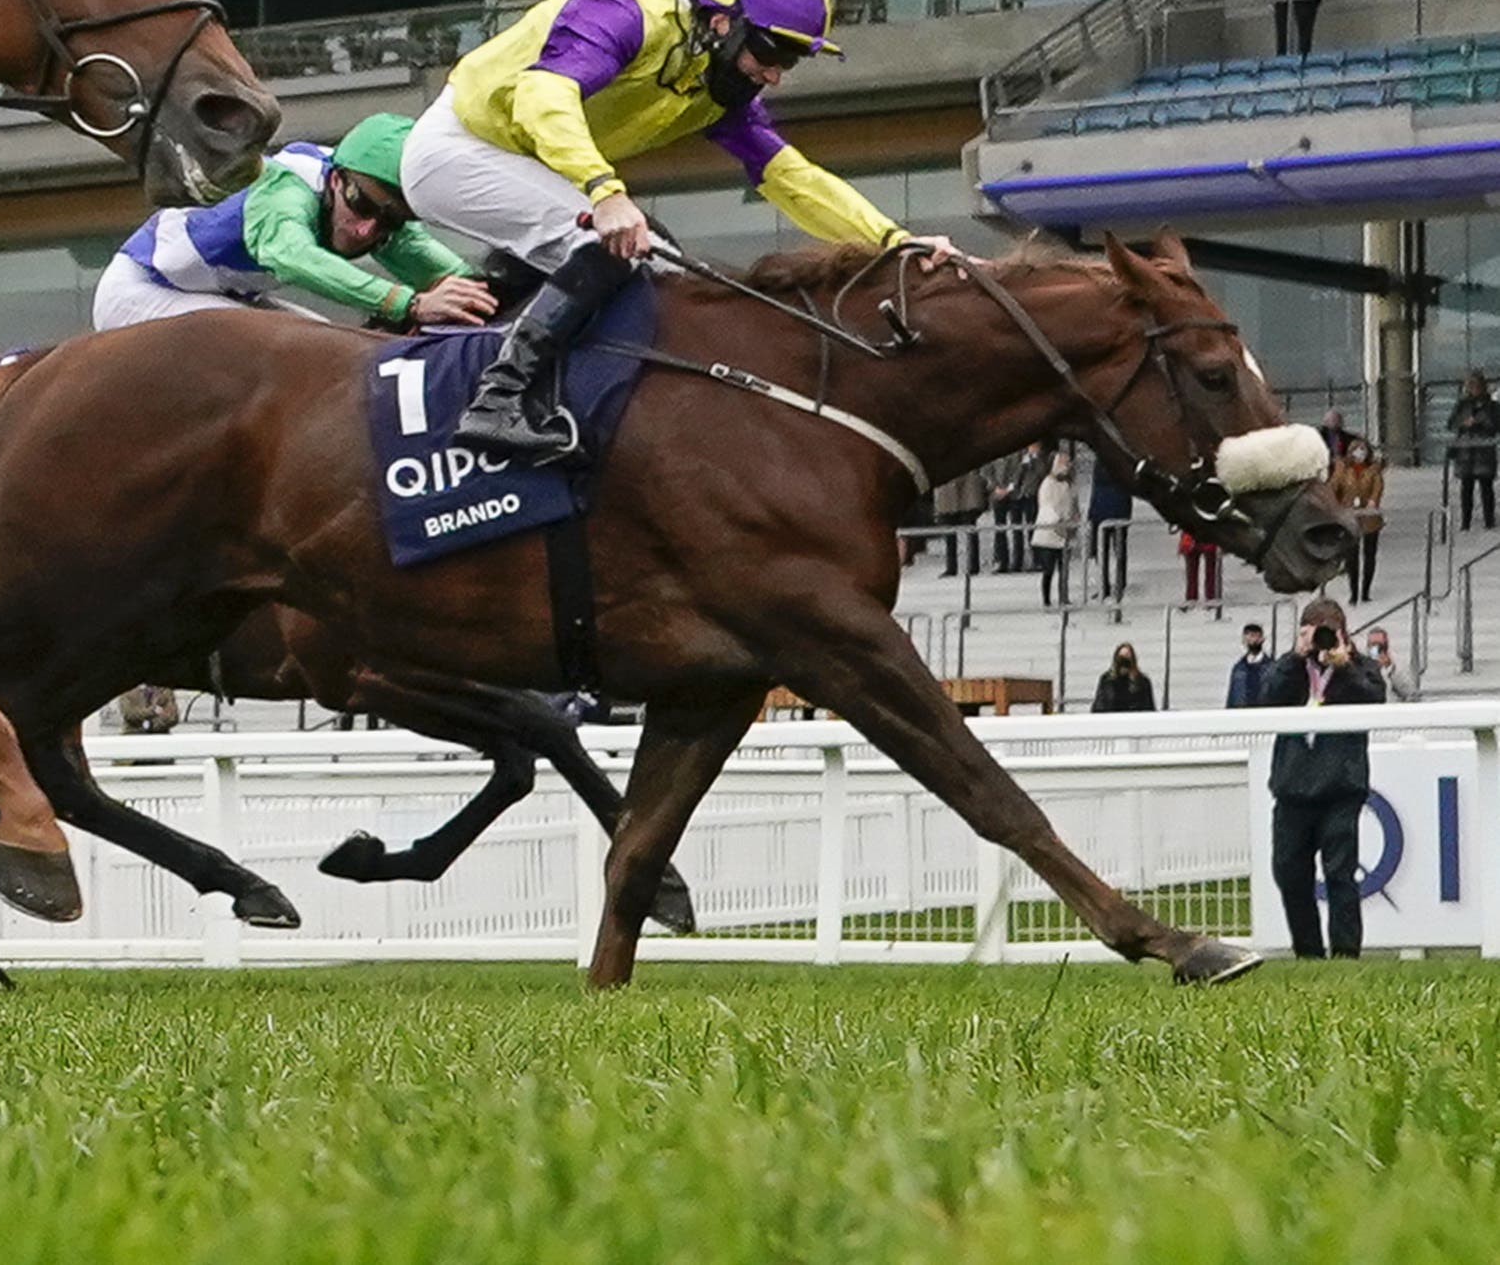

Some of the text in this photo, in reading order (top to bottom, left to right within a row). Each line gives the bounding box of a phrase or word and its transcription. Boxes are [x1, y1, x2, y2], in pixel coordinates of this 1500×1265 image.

[378, 357, 428, 436] 1
[386, 447, 511, 498] QIP
[424, 493, 521, 537] BRANDO
